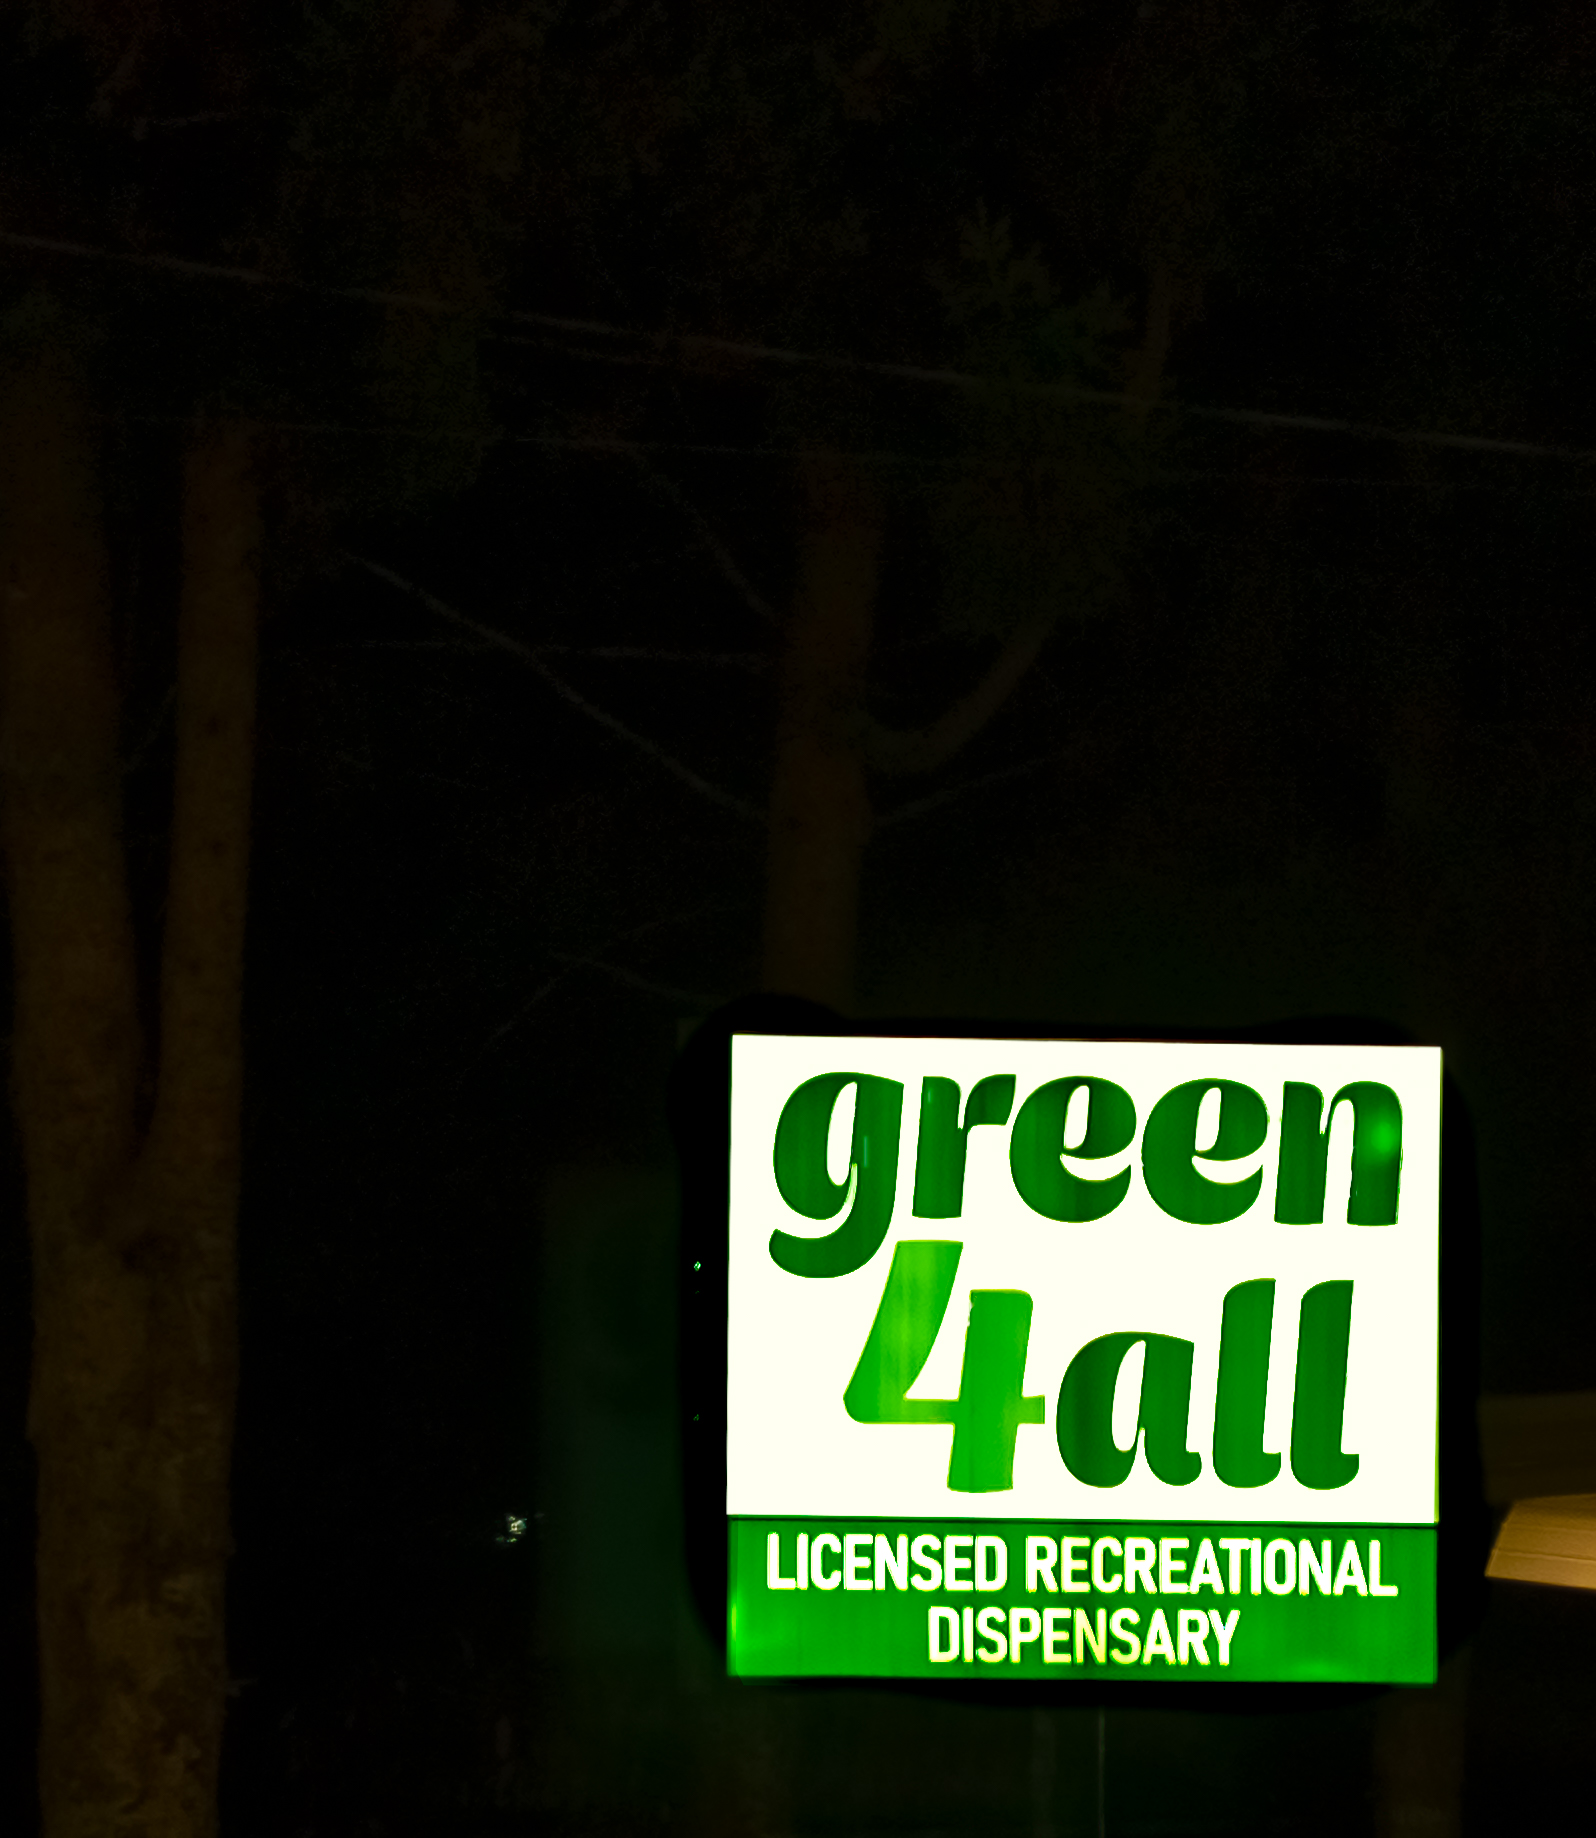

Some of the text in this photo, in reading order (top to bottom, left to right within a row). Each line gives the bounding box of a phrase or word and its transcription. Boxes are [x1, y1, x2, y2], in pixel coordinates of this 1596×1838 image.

[768, 1071, 1404, 1279] green
[843, 1239, 1360, 1494] 4all
[767, 1532, 1399, 1597] LICENSED RECREATIONAL
[927, 1606, 1241, 1667] DISPENSARY
